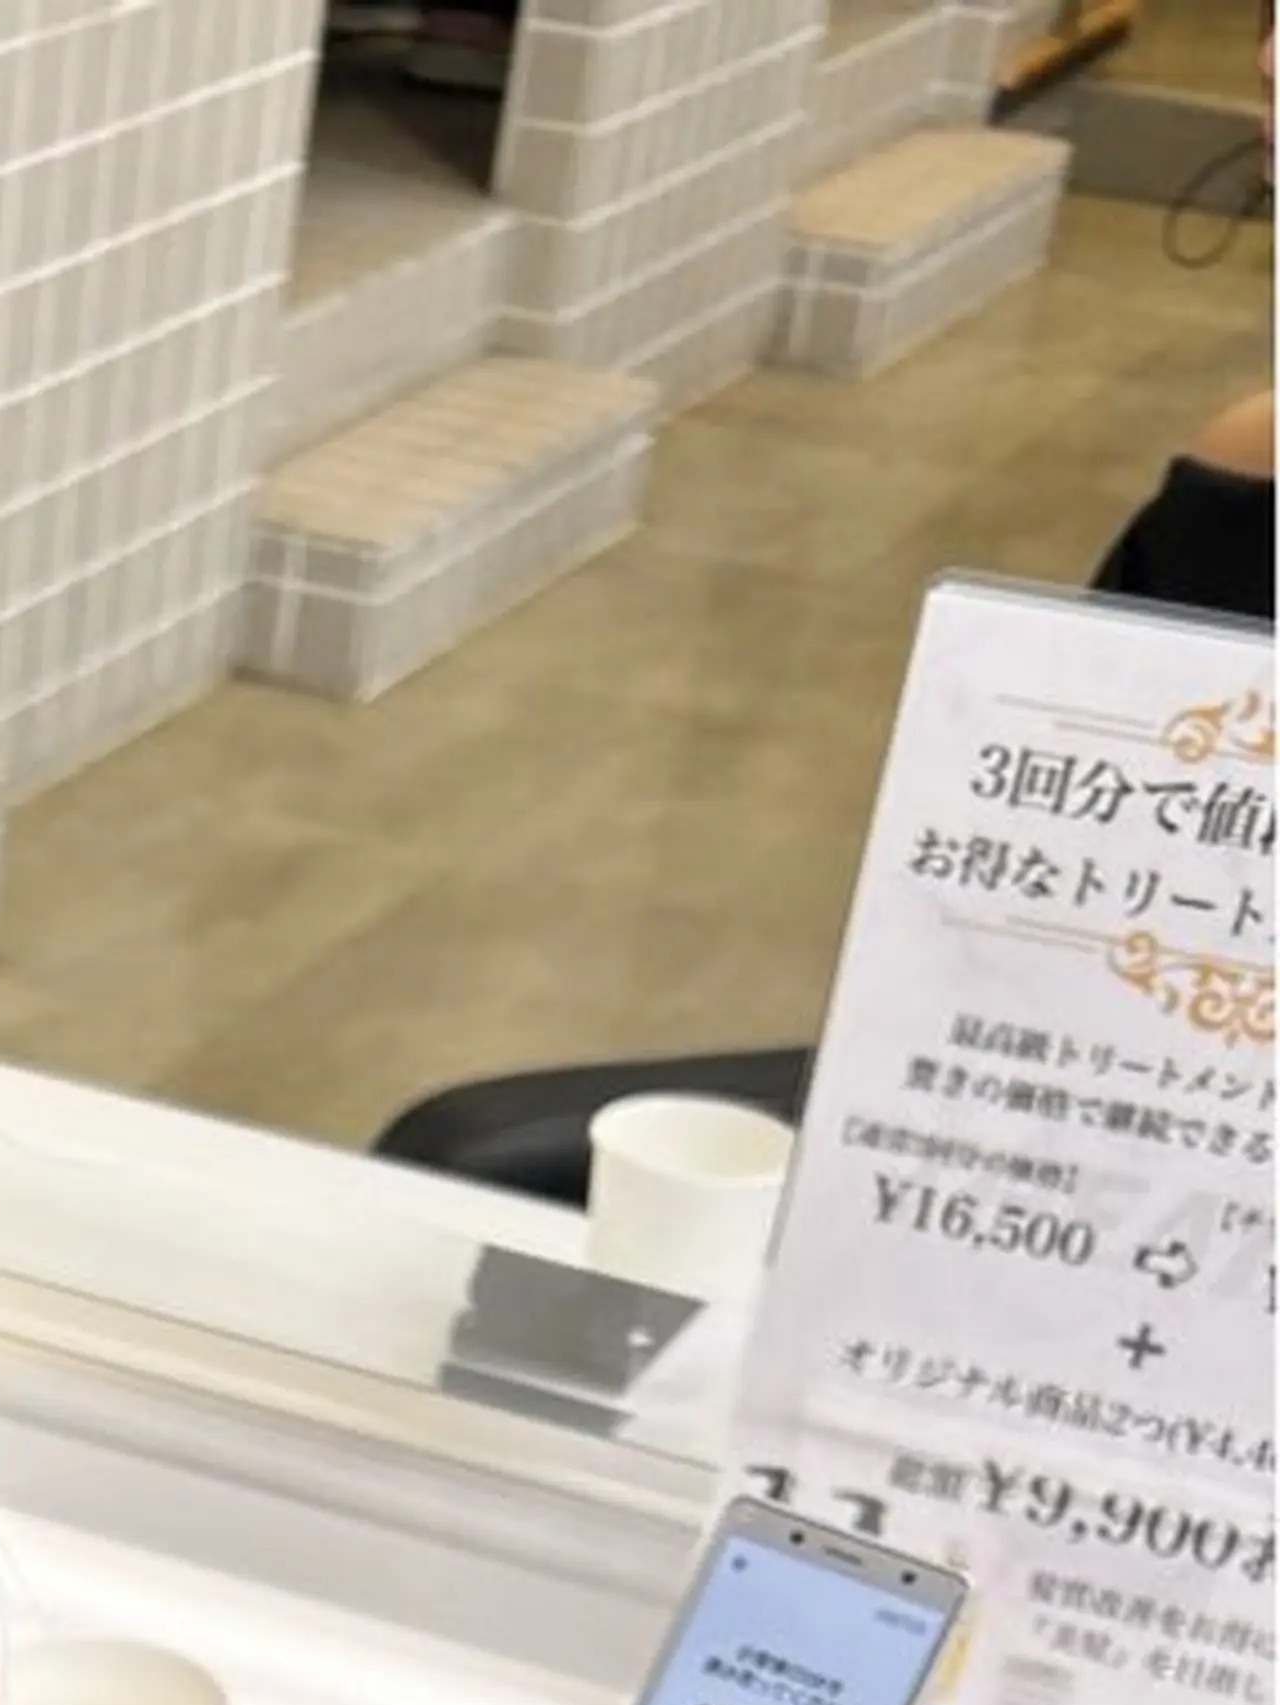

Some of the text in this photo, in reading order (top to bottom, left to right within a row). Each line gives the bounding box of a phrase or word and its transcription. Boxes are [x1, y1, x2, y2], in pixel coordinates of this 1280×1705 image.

[969, 744, 1275, 857] 3回分で値
[909, 829, 1275, 940] お得なトリート
